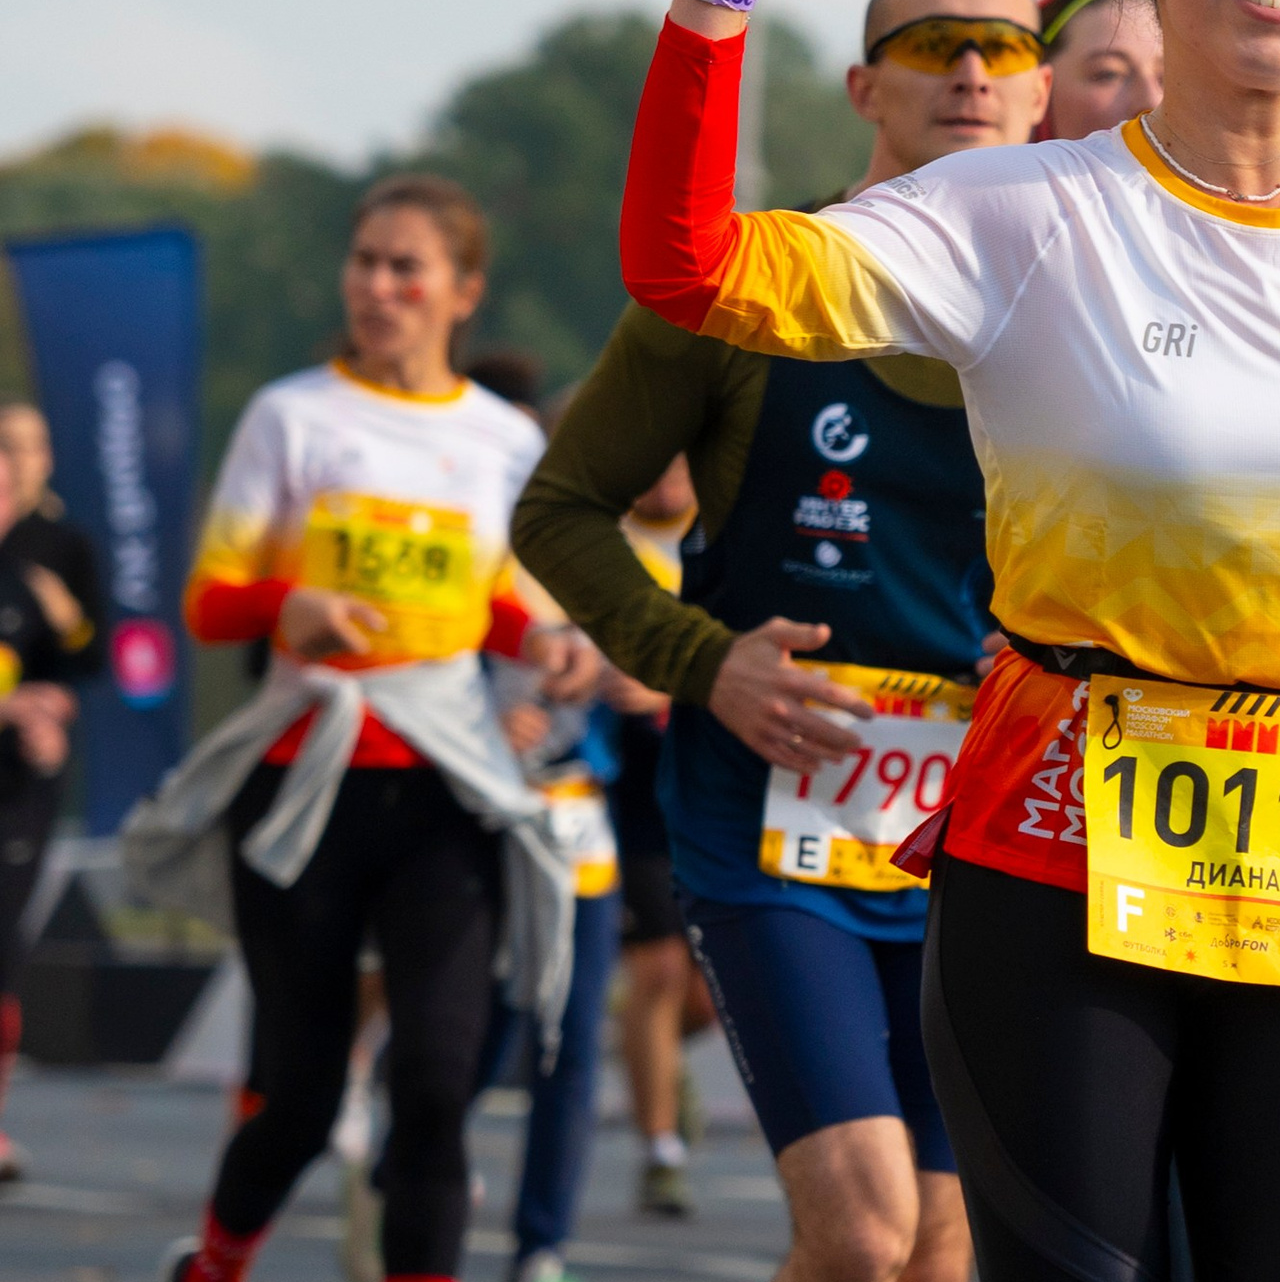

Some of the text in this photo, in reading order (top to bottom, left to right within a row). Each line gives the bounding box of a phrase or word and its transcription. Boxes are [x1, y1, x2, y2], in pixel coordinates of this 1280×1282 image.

[1142, 320, 1199, 358] GRi
[1126, 713, 1173, 724] МАРАФОН
[1127, 704, 1191, 718] МОСКОВСКИЙ
[1125, 721, 1166, 732] MOSCOW
[1125, 728, 1175, 740] MARATHON
[797, 835, 819, 869] E
[1186, 861, 1280, 892] ДИАНА
[1117, 884, 1145, 933] F
[1123, 940, 1168, 957] ФУТБОЛКА
